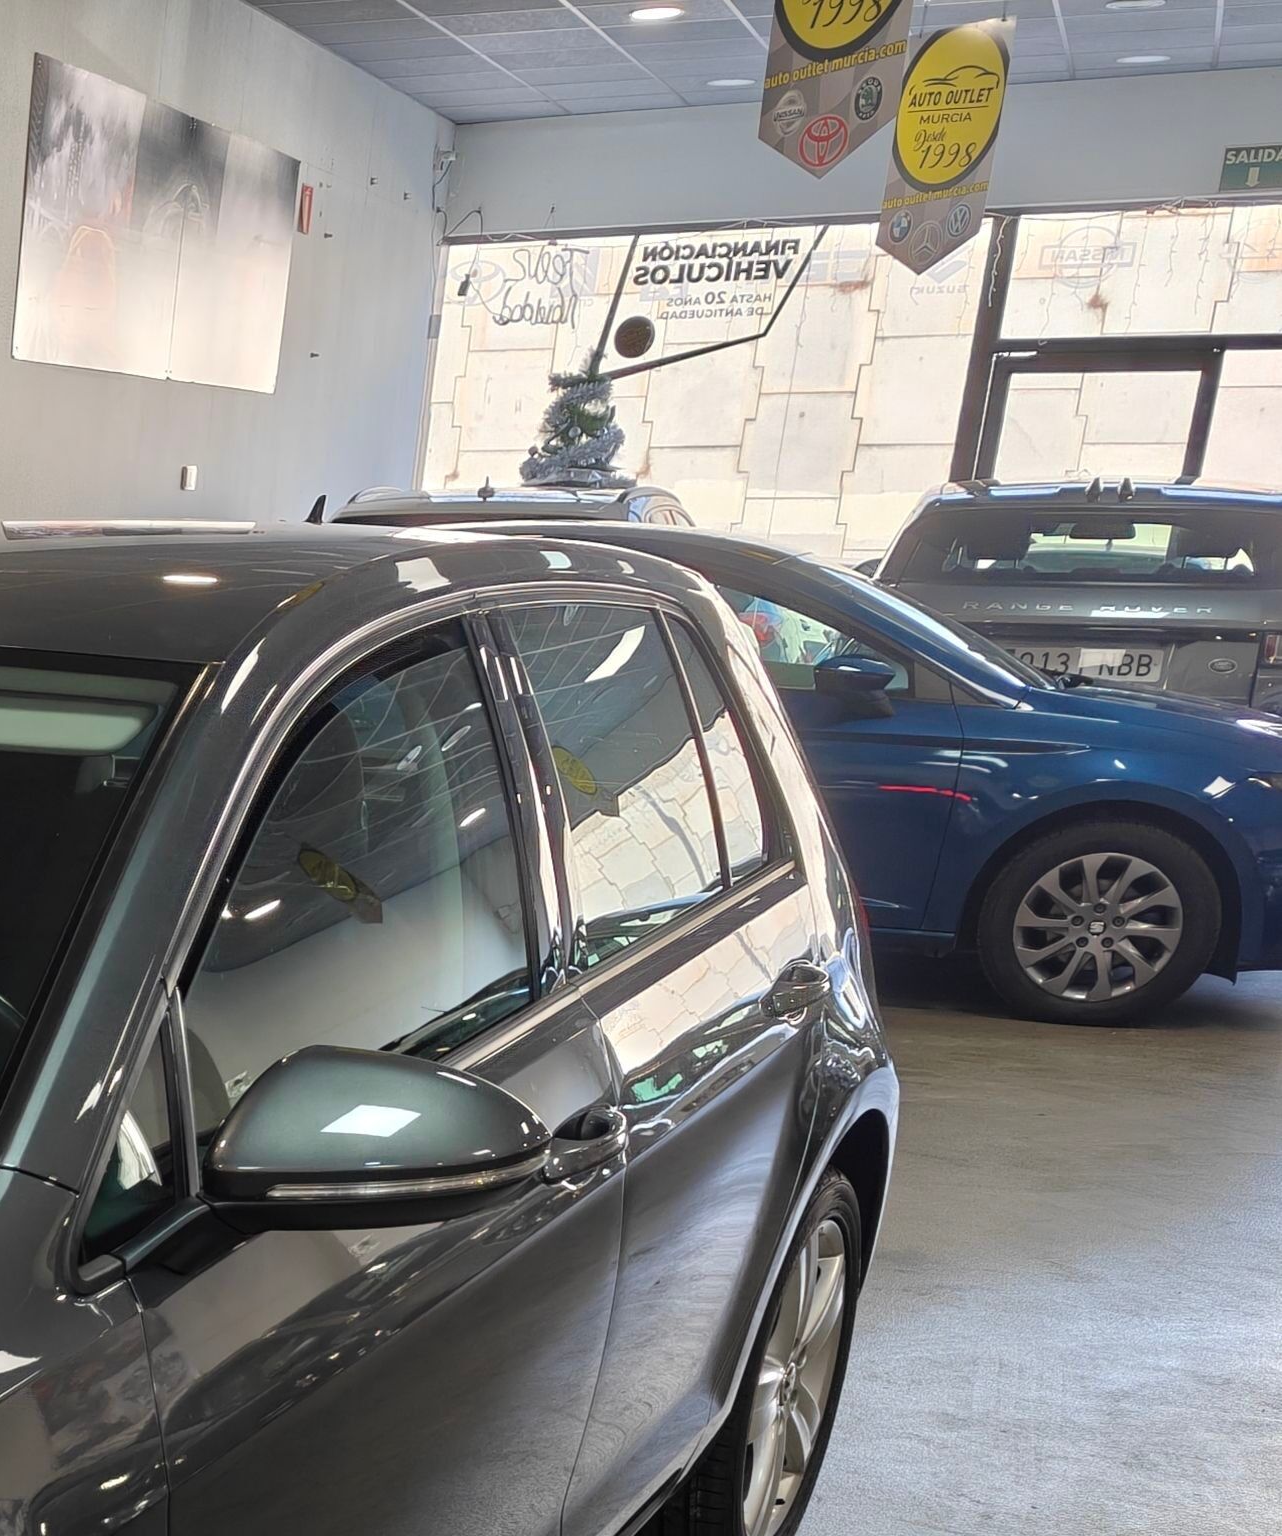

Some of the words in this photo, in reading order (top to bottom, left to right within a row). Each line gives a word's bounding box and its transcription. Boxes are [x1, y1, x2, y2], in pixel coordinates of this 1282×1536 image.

[764, 73, 790, 89] auto
[792, 59, 829, 81] outlet
[831, 40, 908, 71] murcia.com
[908, 91, 942, 108] AUTO
[945, 87, 994, 105] OUTLET
[919, 112, 973, 125] MURCIA
[919, 142, 977, 169] 1998
[882, 198, 903, 209] auto
[904, 190, 932, 205] outlet
[932, 180, 989, 201] murcia.com
[962, 600, 1074, 611] RANGE
